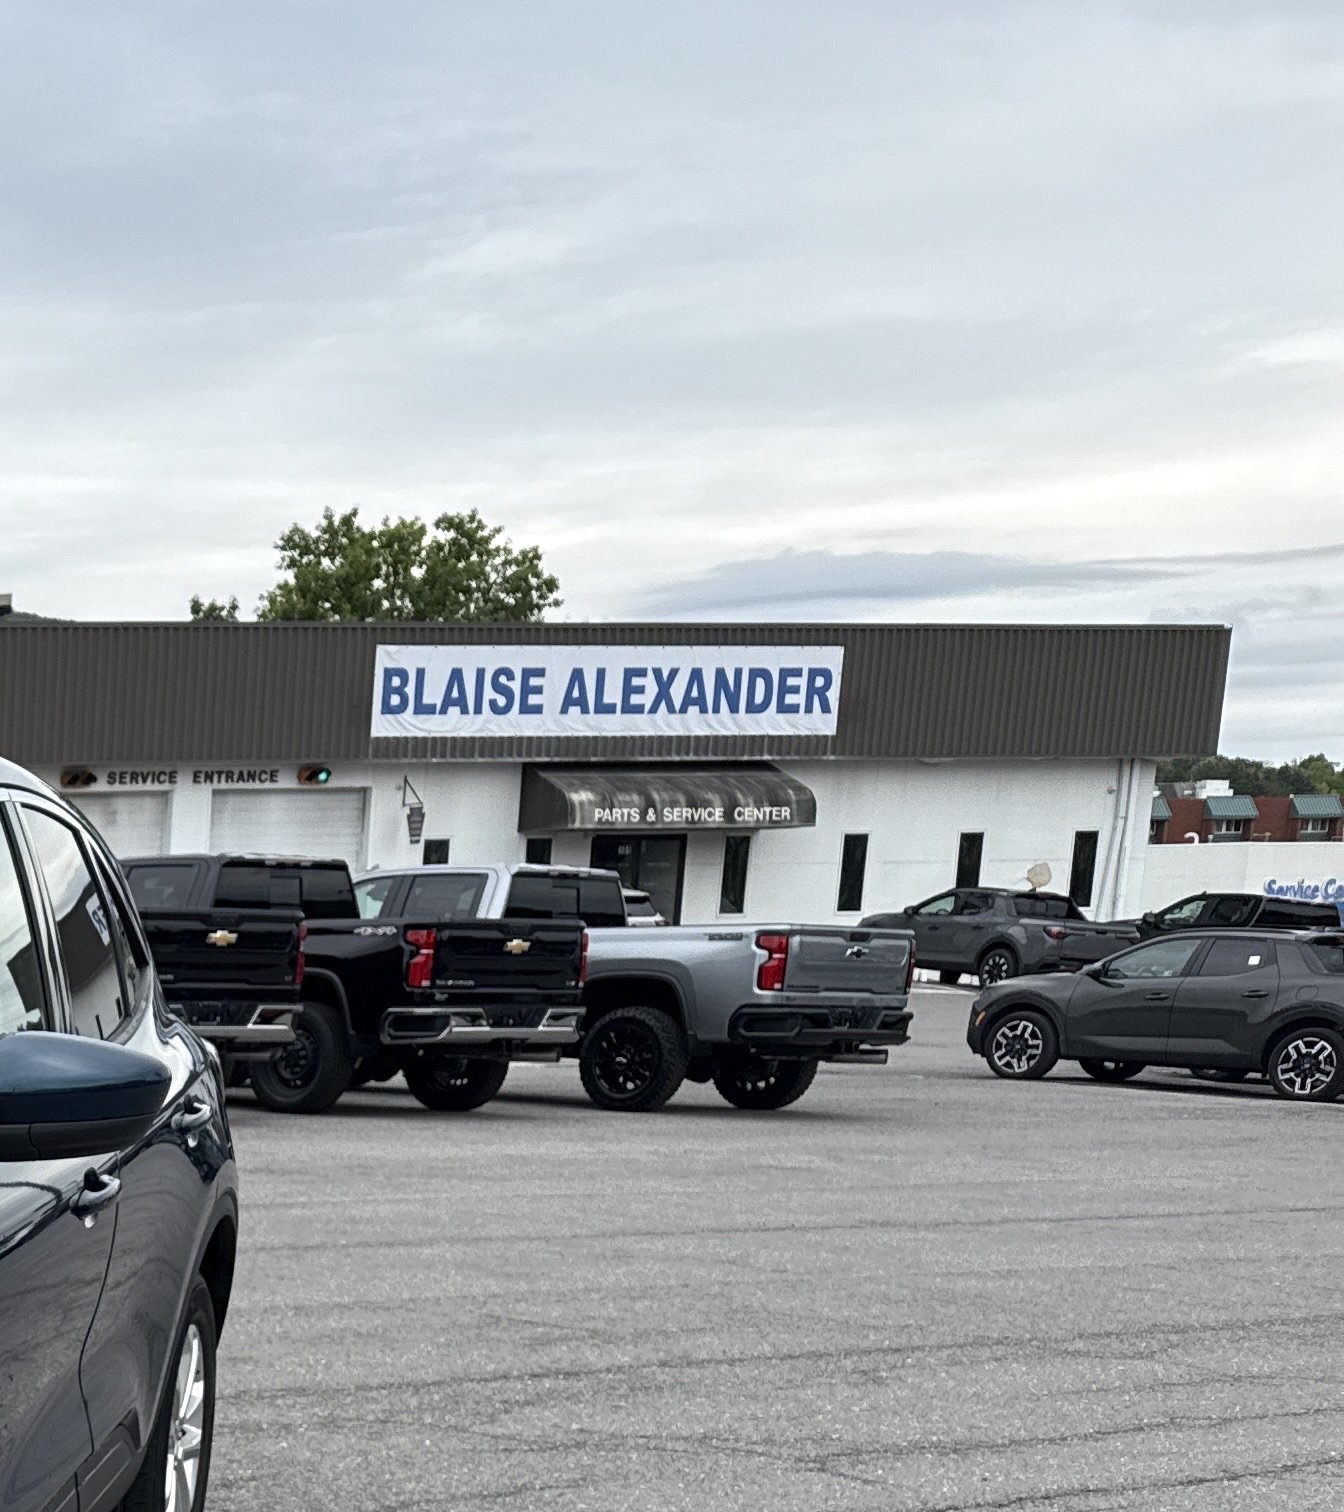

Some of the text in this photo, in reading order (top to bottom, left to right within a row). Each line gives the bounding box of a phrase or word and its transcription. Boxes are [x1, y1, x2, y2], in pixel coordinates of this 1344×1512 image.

[380, 667, 834, 716] BLAISE ALEXANDER
[106, 768, 280, 786] SERVICE ENTRANCE
[594, 806, 791, 822] PARTS & SERVICE CENTER
